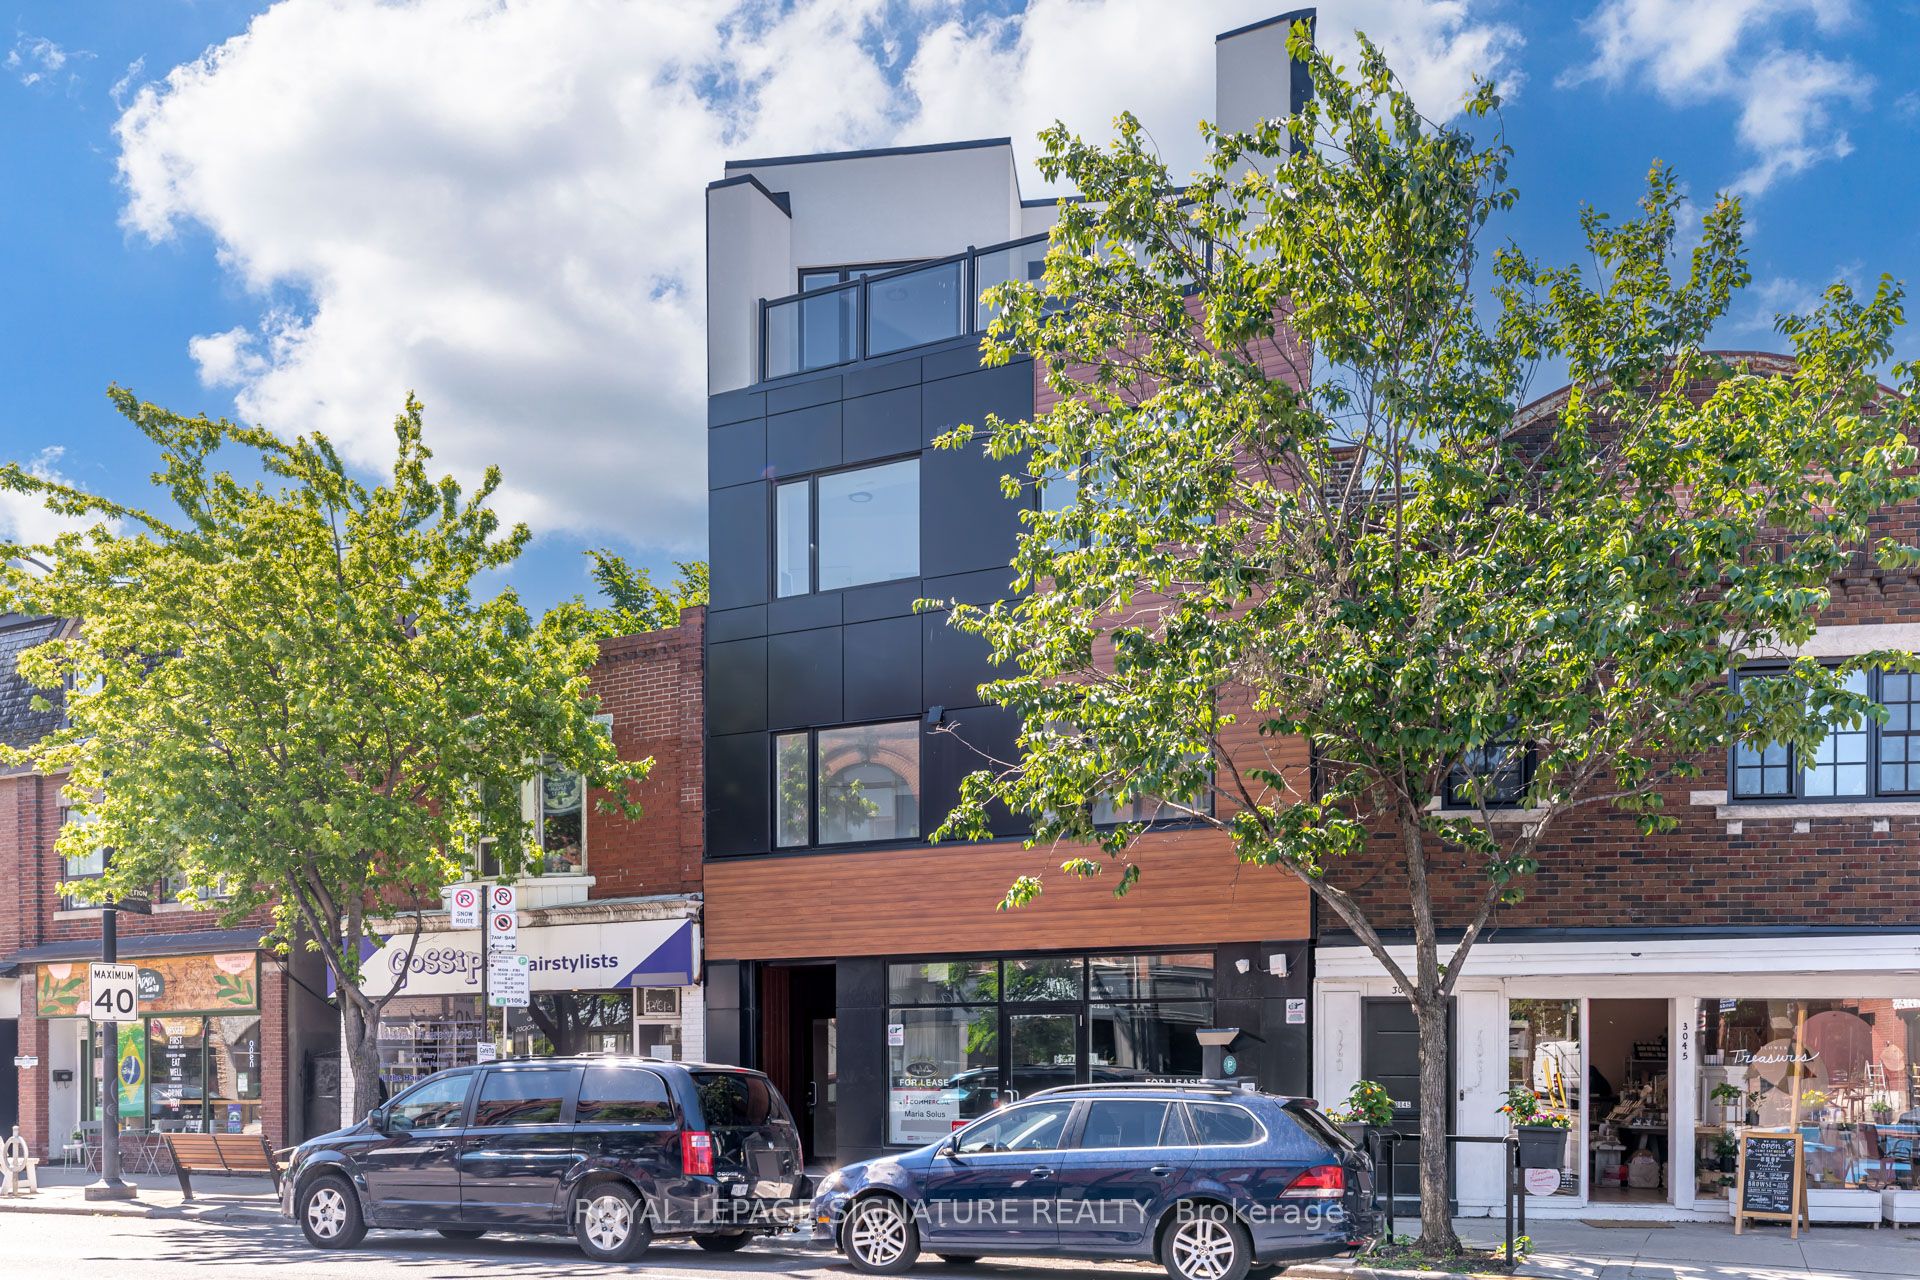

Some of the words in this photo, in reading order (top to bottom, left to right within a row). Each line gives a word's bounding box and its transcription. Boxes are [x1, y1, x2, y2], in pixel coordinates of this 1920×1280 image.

[529, 954, 619, 973] airstylists
[94, 969, 134, 981] MAXIMUM
[94, 988, 134, 1014] 40
[1681, 1022, 1689, 1060] 3045
[1729, 1048, 1820, 1064] Treasures
[171, 1058, 181, 1067] EAT
[169, 1068, 183, 1077] WELL
[899, 1078, 918, 1087] FOR
[920, 1078, 950, 1087] LEASE
[926, 1110, 946, 1118] Solus
